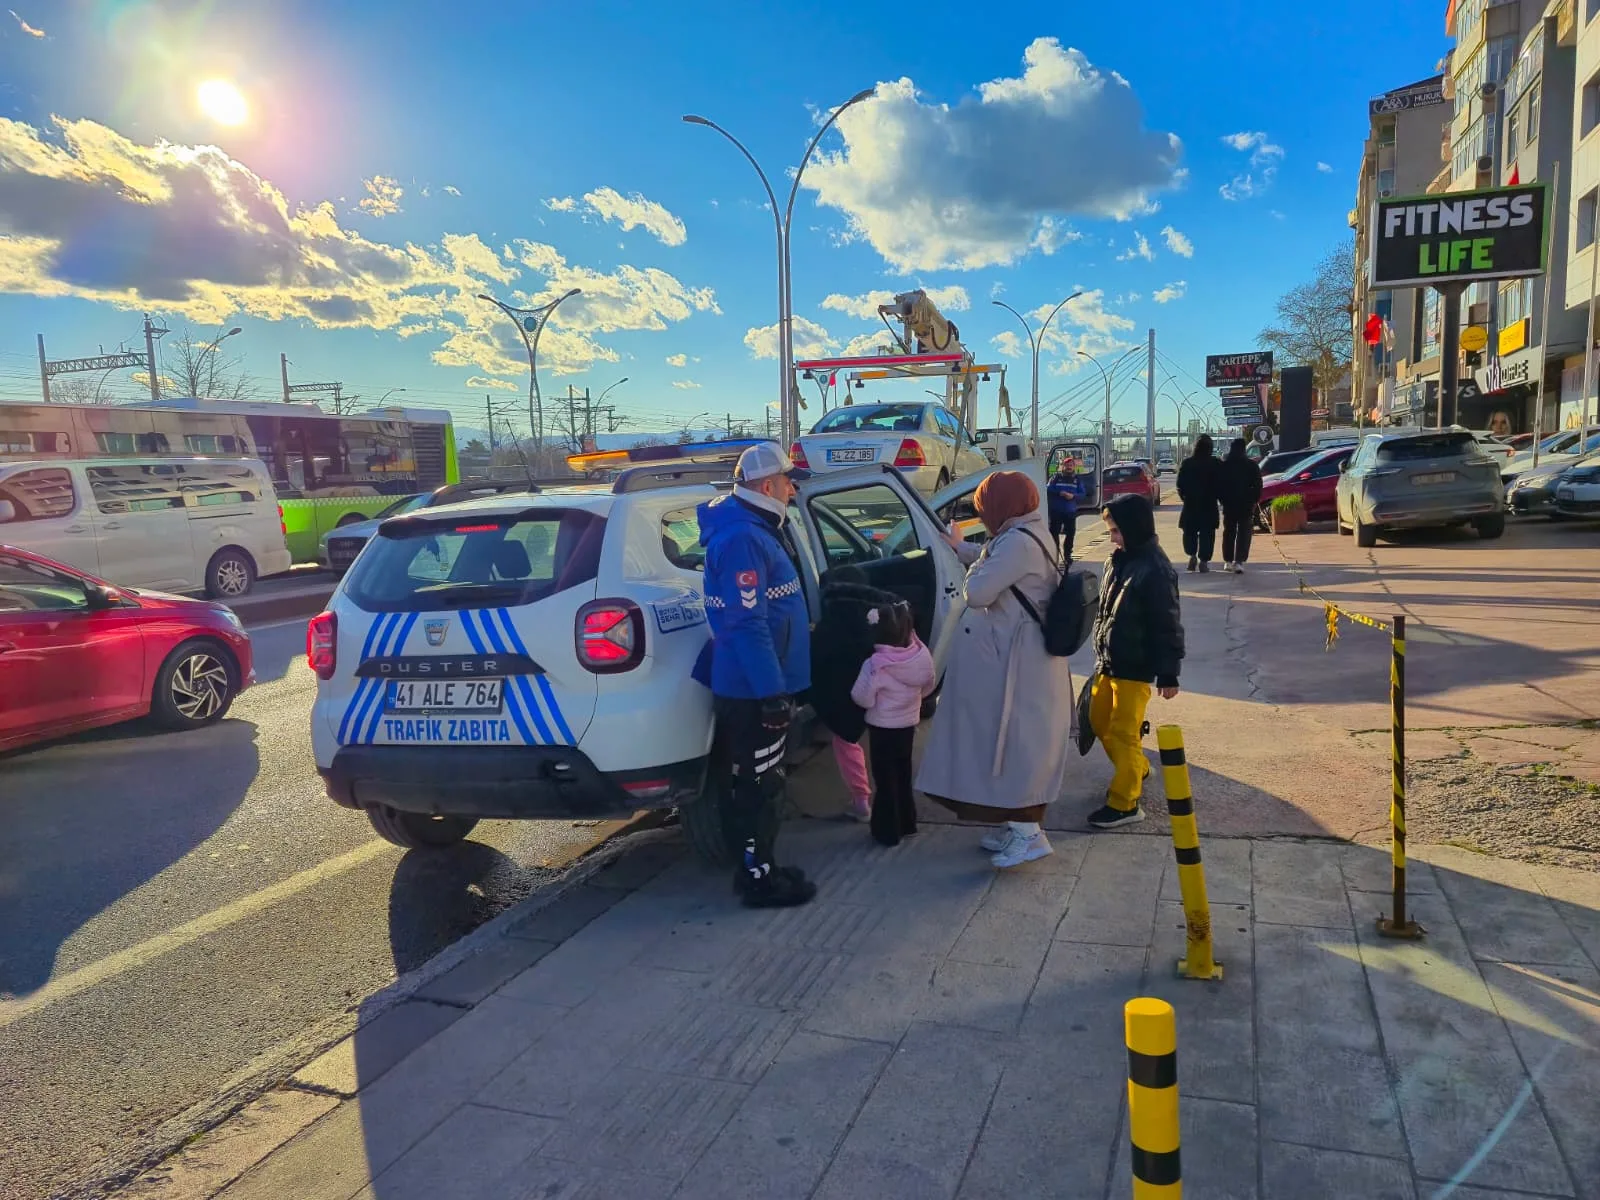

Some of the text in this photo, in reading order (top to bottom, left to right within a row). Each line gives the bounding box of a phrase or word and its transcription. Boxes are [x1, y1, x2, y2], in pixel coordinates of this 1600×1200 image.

[1385, 194, 1533, 238] FITNESS
[1419, 237, 1495, 274] LIFE
[1219, 354, 1261, 366] KARTEPE
[844, 450, 856, 460] ZZ
[380, 661, 498, 673] DUSTER
[397, 683, 498, 706] 41 ALE 764
[384, 716, 511, 741] TRAFİK ZABITA
